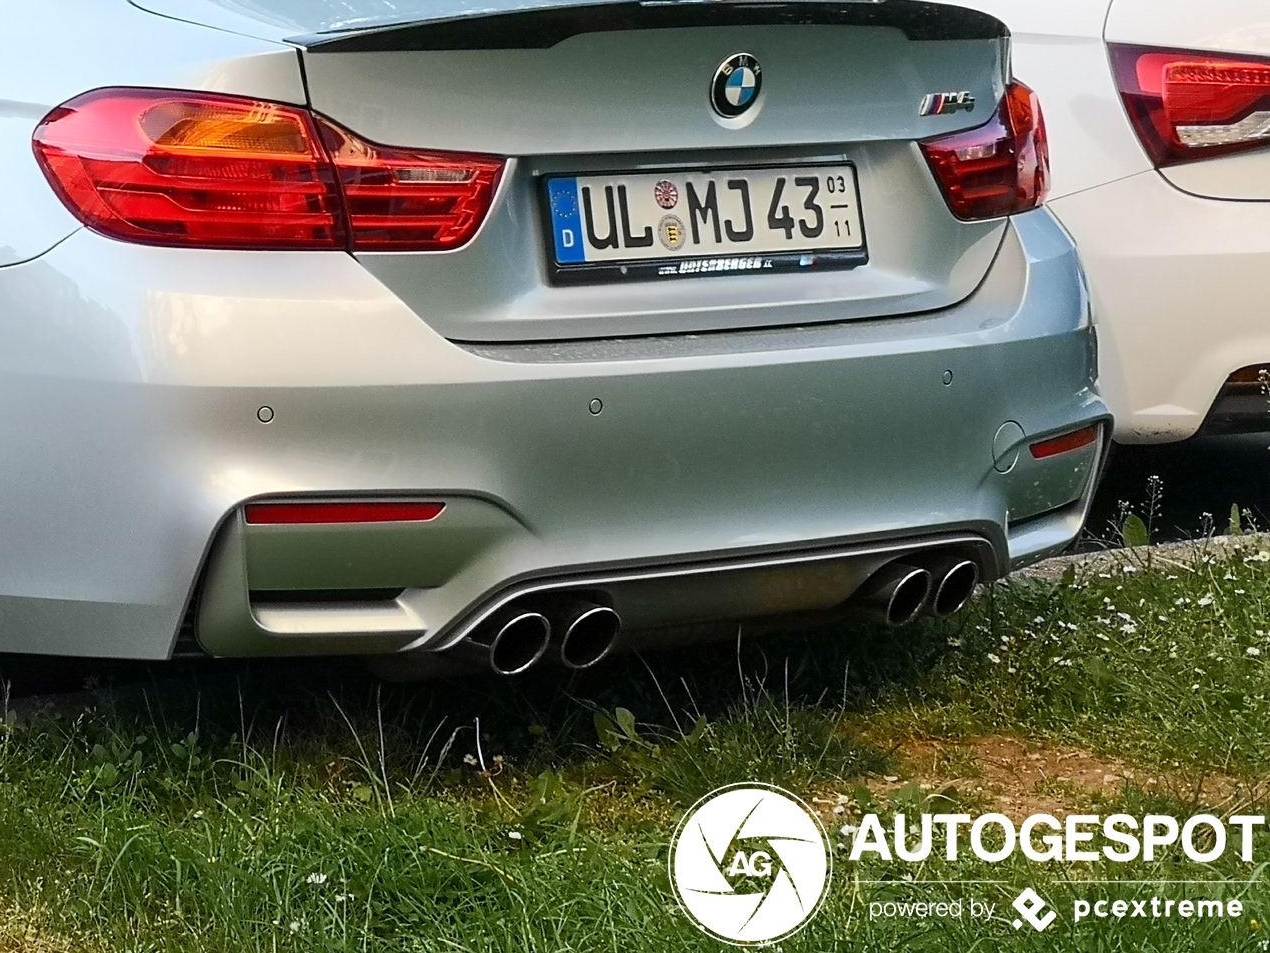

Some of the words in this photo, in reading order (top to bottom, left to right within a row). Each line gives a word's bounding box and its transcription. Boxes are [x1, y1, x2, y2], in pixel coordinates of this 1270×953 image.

[827, 176, 847, 194] 03
[582, 185, 654, 249] UL
[685, 179, 754, 244] MJ
[768, 176, 824, 240] 43
[562, 228, 575, 248] D
[834, 220, 851, 237] 11
